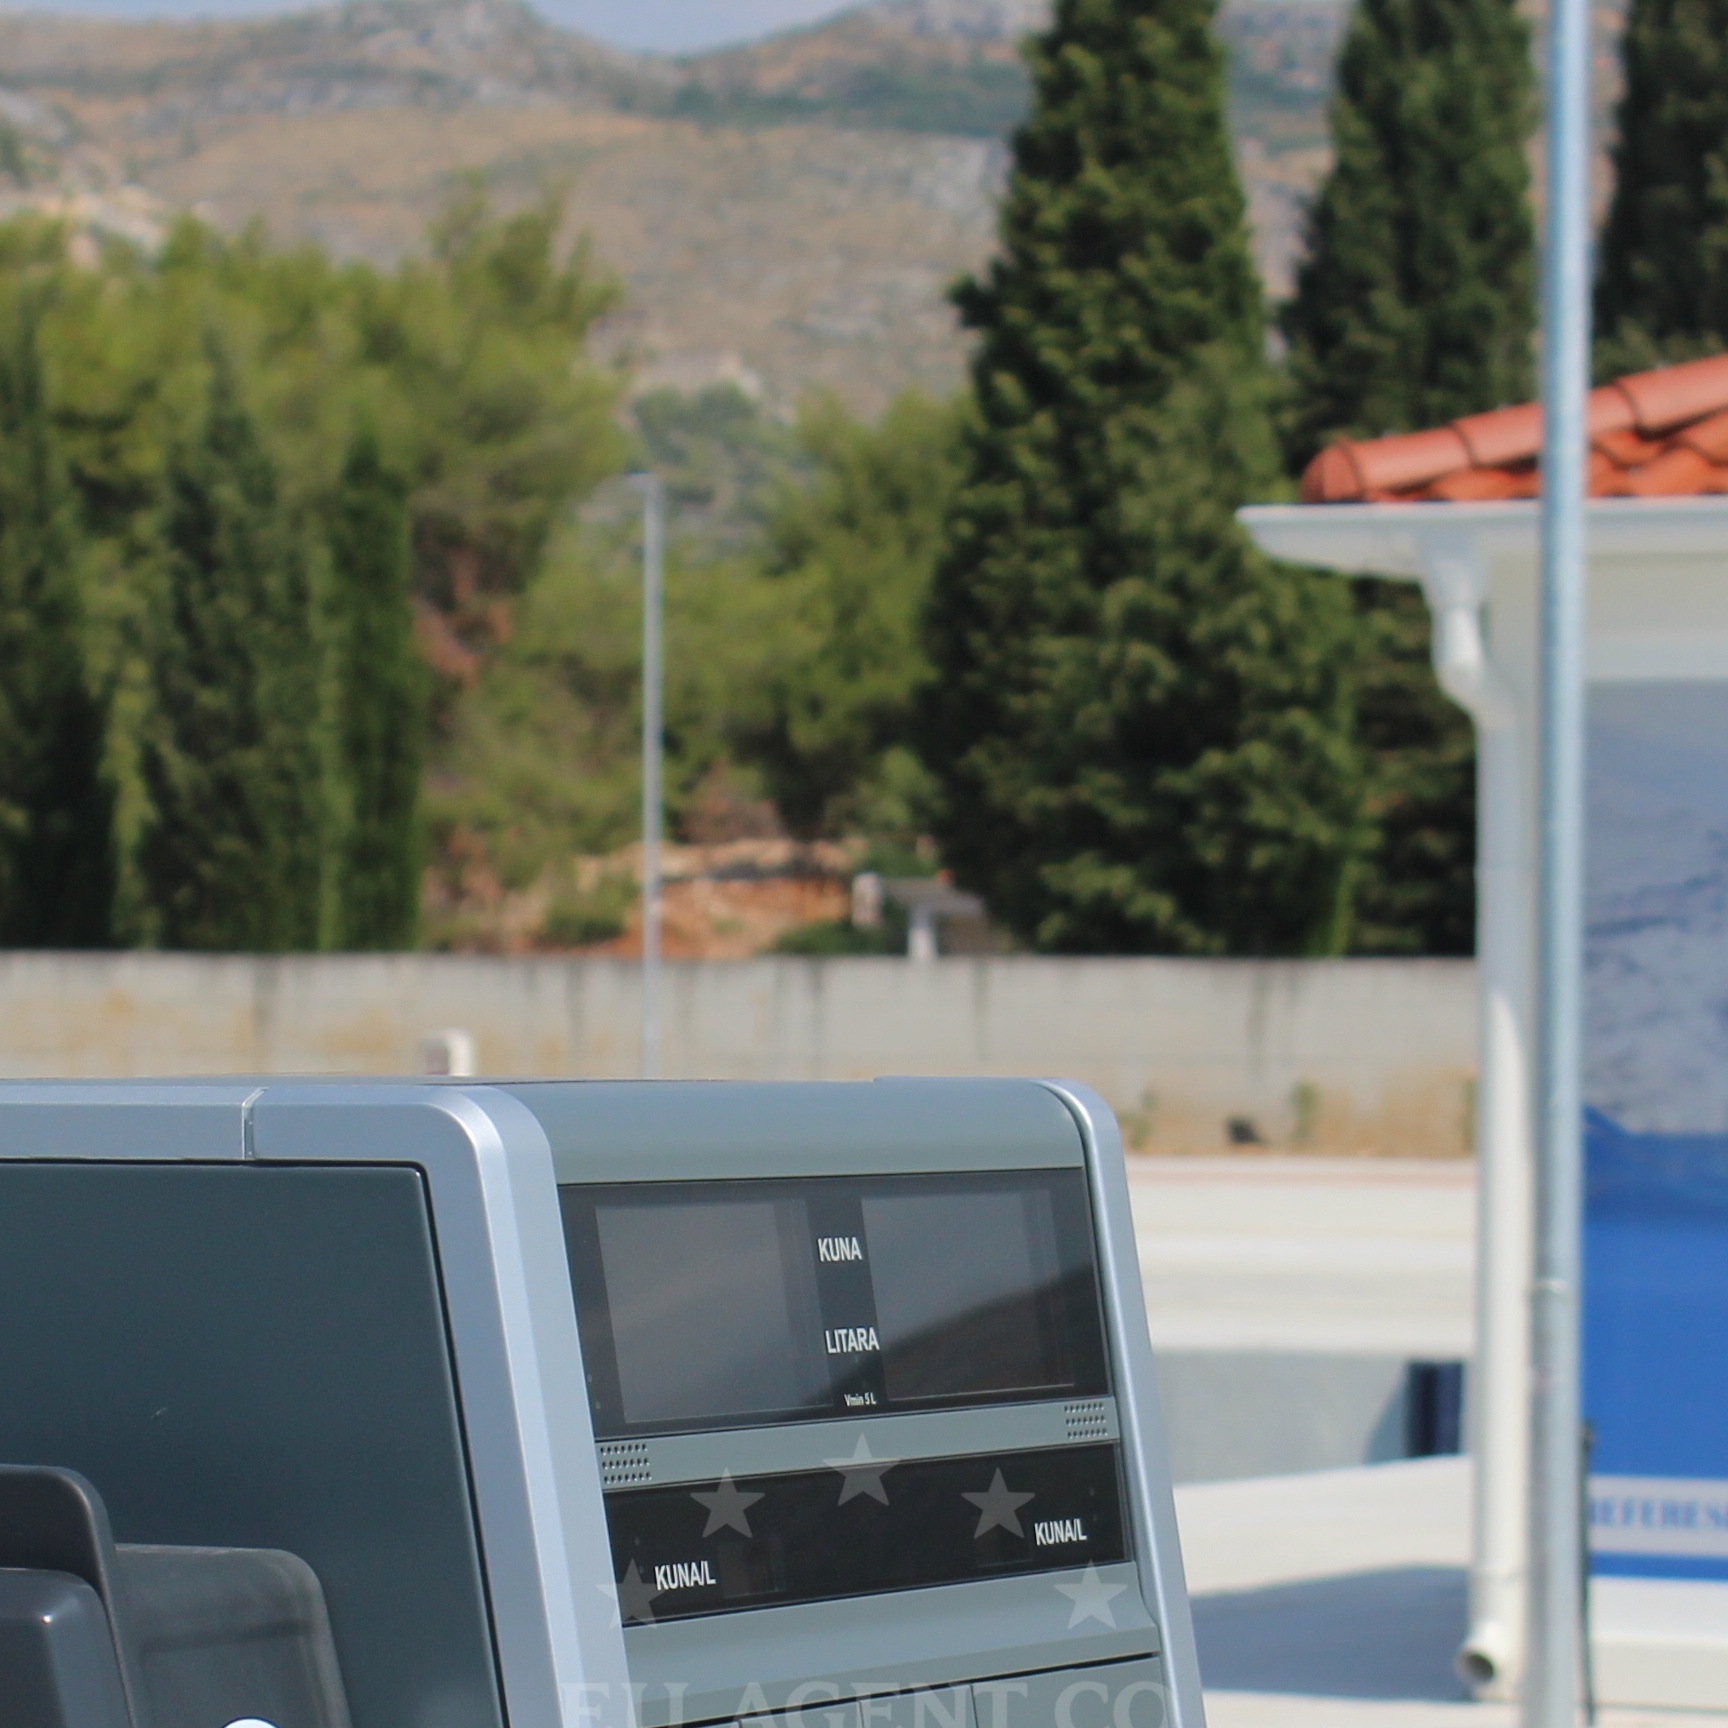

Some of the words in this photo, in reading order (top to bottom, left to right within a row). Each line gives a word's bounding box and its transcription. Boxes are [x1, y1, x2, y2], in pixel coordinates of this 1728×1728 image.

[818, 1237, 862, 1262] KUNA
[825, 1327, 880, 1353] LITARA
[870, 1392, 877, 1405] L
[1034, 1518, 1087, 1546] KUNA/L
[654, 1560, 716, 1591] KUNA/L
